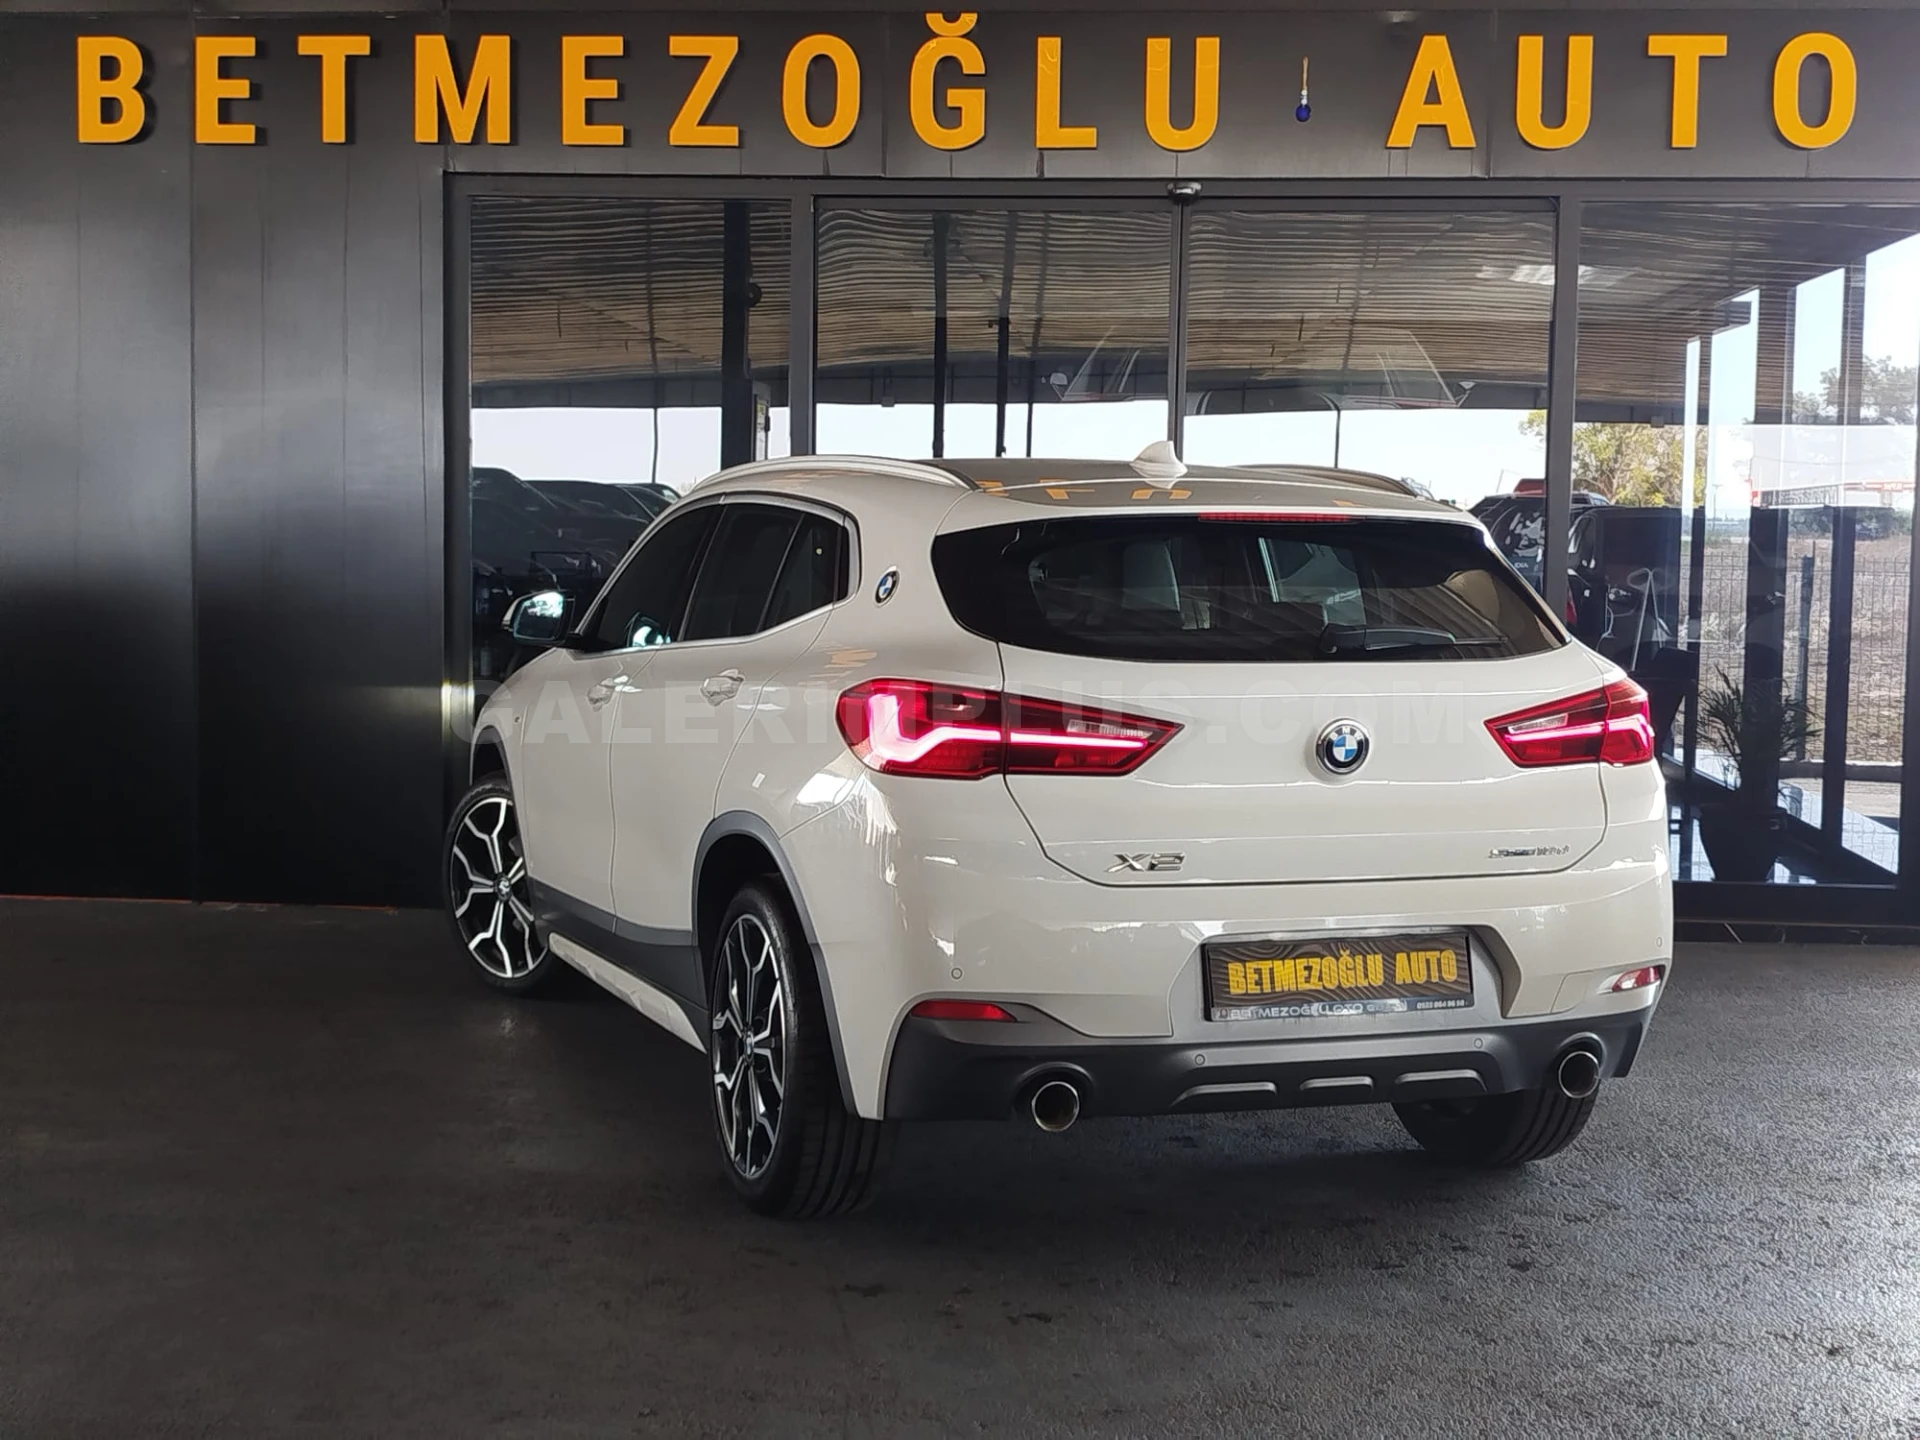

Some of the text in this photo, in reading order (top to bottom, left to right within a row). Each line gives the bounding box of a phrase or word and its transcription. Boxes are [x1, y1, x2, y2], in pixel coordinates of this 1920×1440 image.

[76, 12, 1858, 151] BETMEZOĞLU AUTO
[1103, 852, 1186, 873] X2
[1227, 949, 1458, 995] BETMEZOĞLU AUTO
